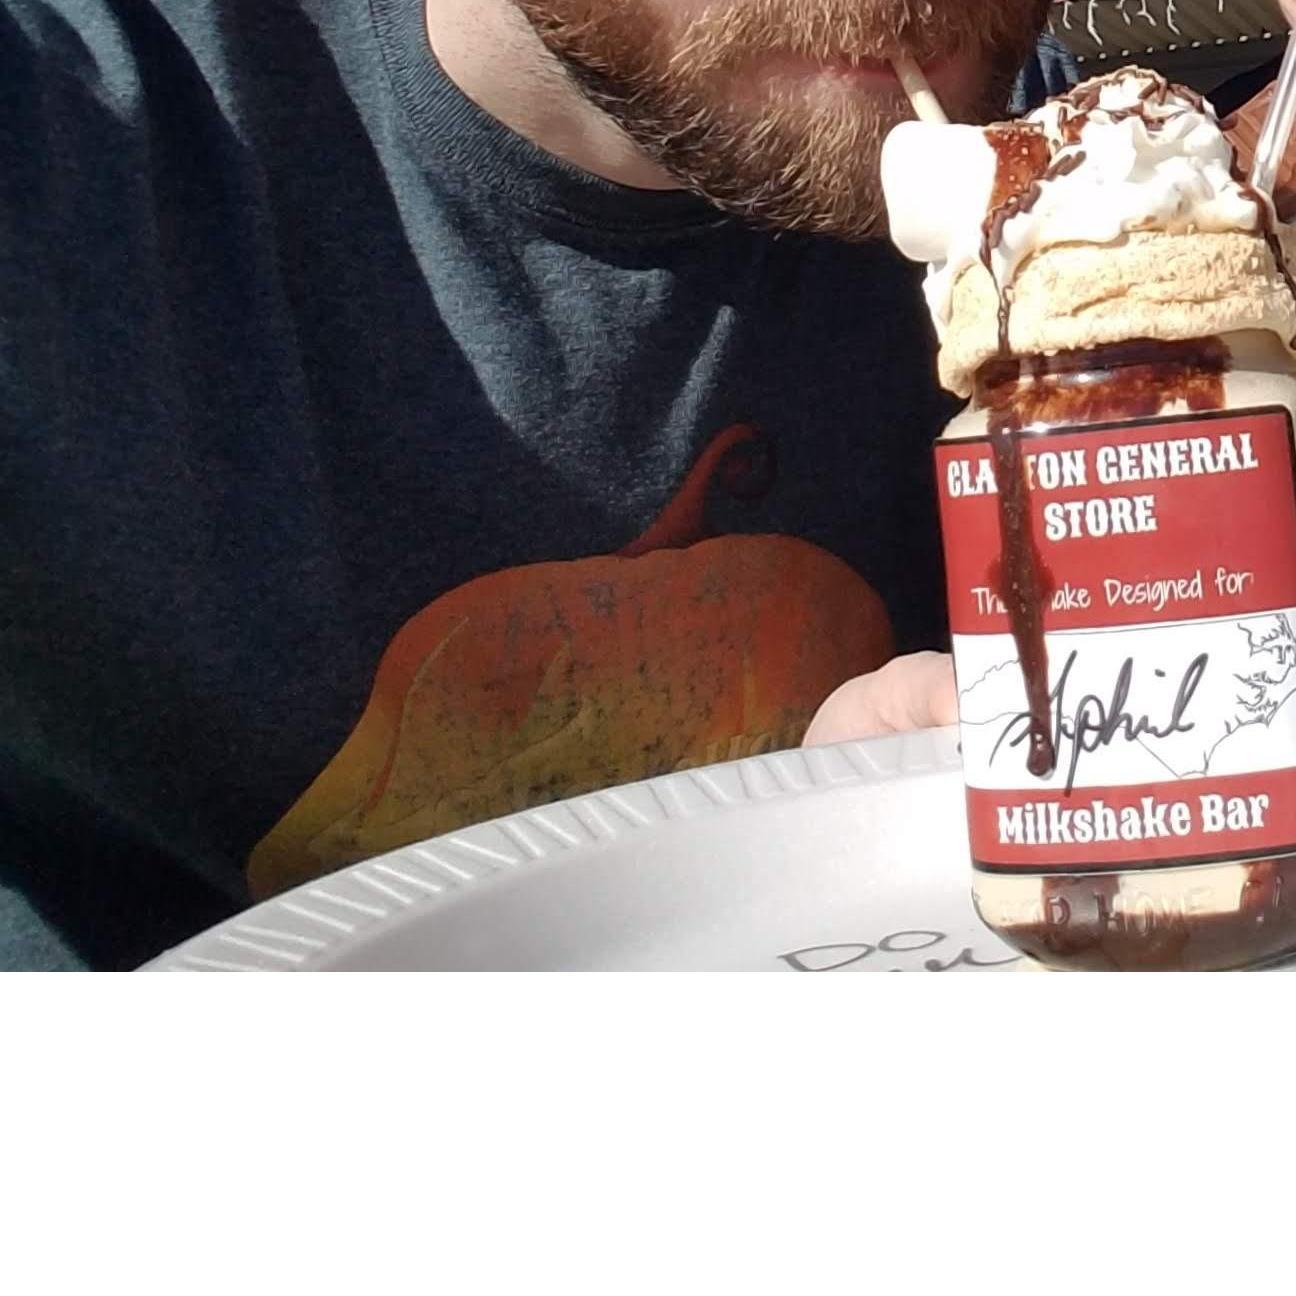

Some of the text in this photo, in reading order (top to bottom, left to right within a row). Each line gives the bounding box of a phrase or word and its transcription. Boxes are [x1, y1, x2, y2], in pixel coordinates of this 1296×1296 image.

[947, 432, 1258, 498] CLATON GENERAL
[1044, 494, 1157, 541] STORE
[1104, 569, 1203, 611] Designed
[1214, 566, 1254, 596] for
[997, 793, 1269, 845] Milkshake Bar
